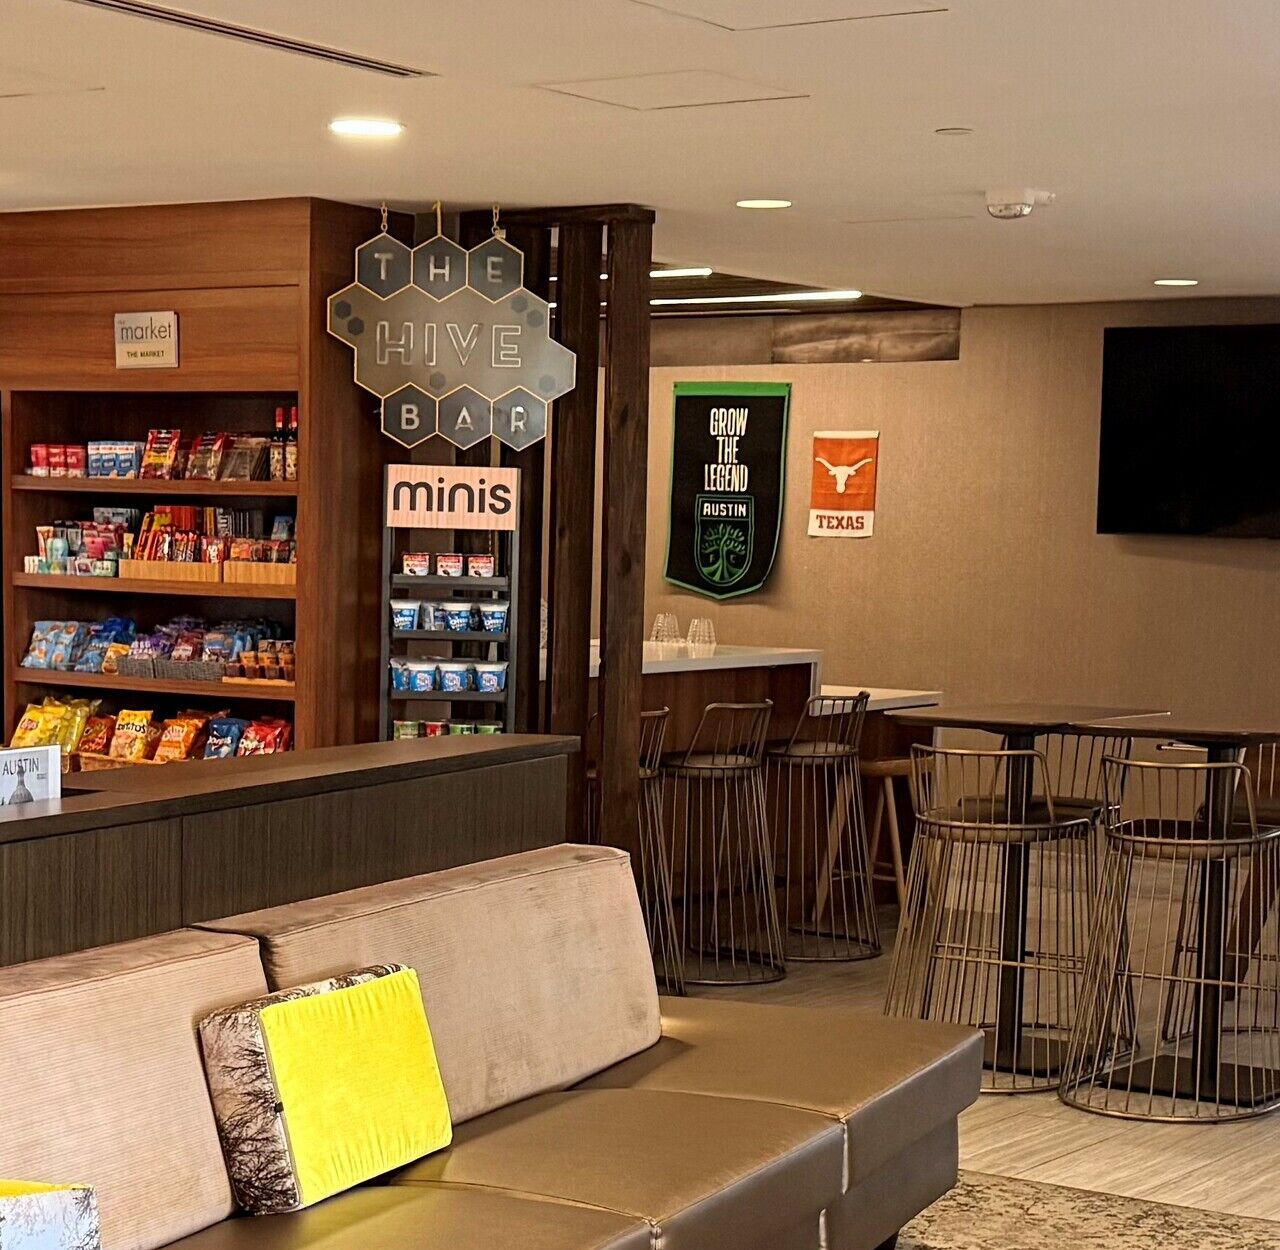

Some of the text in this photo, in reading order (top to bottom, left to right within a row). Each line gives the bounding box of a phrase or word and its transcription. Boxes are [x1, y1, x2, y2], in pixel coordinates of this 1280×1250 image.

[373, 251, 505, 284] THE
[120, 316, 172, 341] market
[126, 350, 165, 359] THE MARKET
[375, 320, 522, 369] HIVE
[400, 402, 528, 434] BAR
[709, 406, 749, 437] GROW
[716, 435, 740, 465] THE
[703, 463, 749, 493] LEGEND
[392, 476, 513, 516] minis
[702, 502, 747, 518] AUSTIN
[815, 513, 866, 531] TEXAS
[1, 757, 40, 777] AUSTIN
